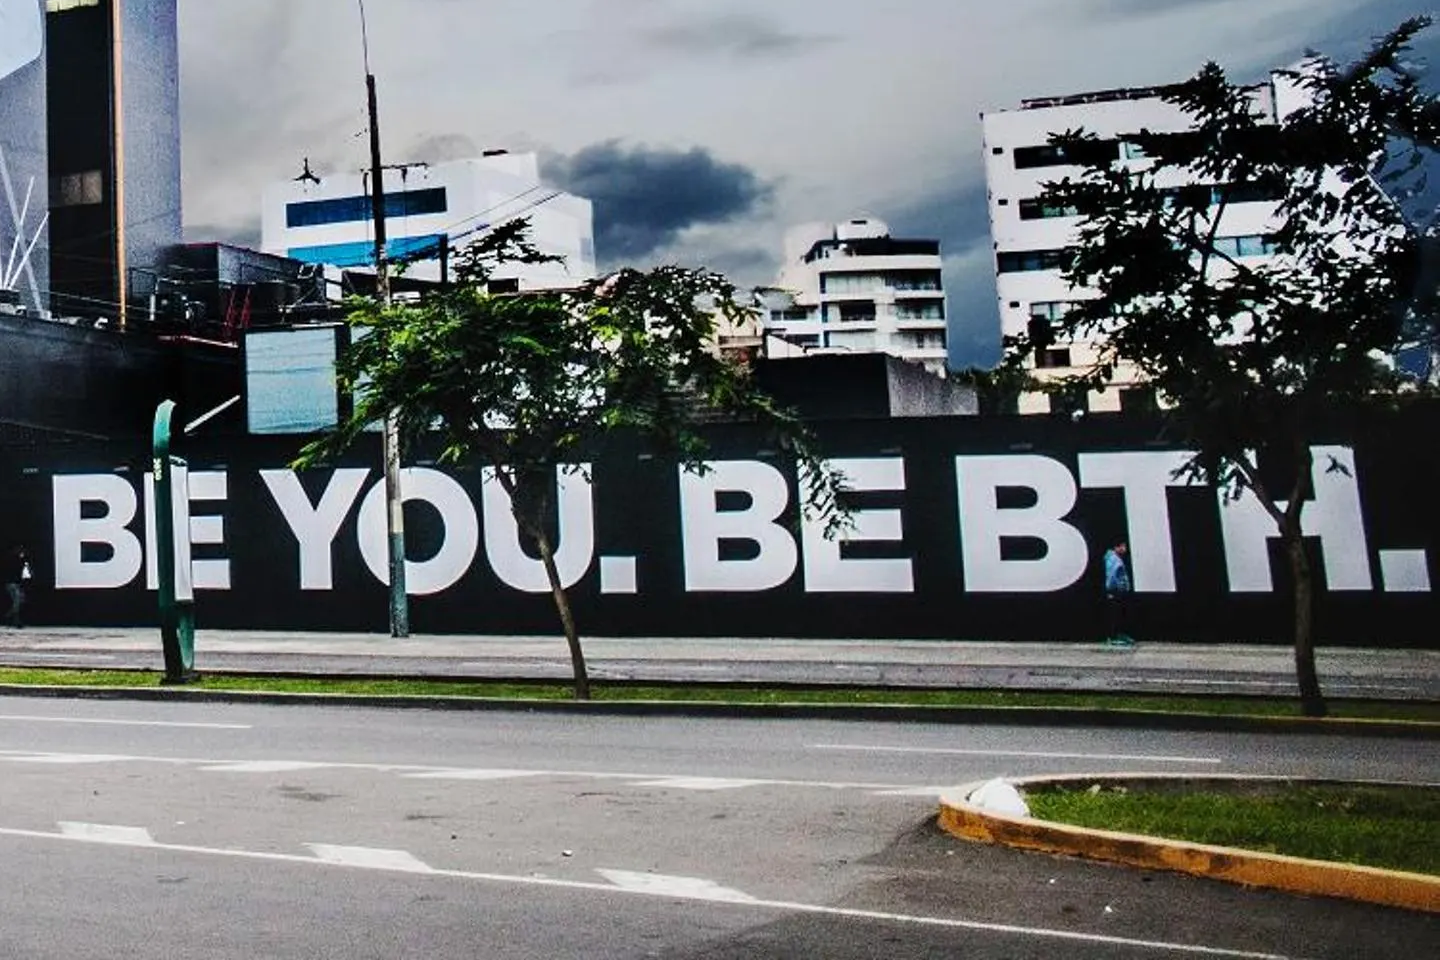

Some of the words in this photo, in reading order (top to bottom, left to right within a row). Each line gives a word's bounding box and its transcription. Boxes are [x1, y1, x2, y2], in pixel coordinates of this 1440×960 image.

[53, 471, 231, 590] BE
[260, 463, 637, 594] YOU.
[678, 456, 914, 592] BE
[956, 445, 1431, 592] BTH.
